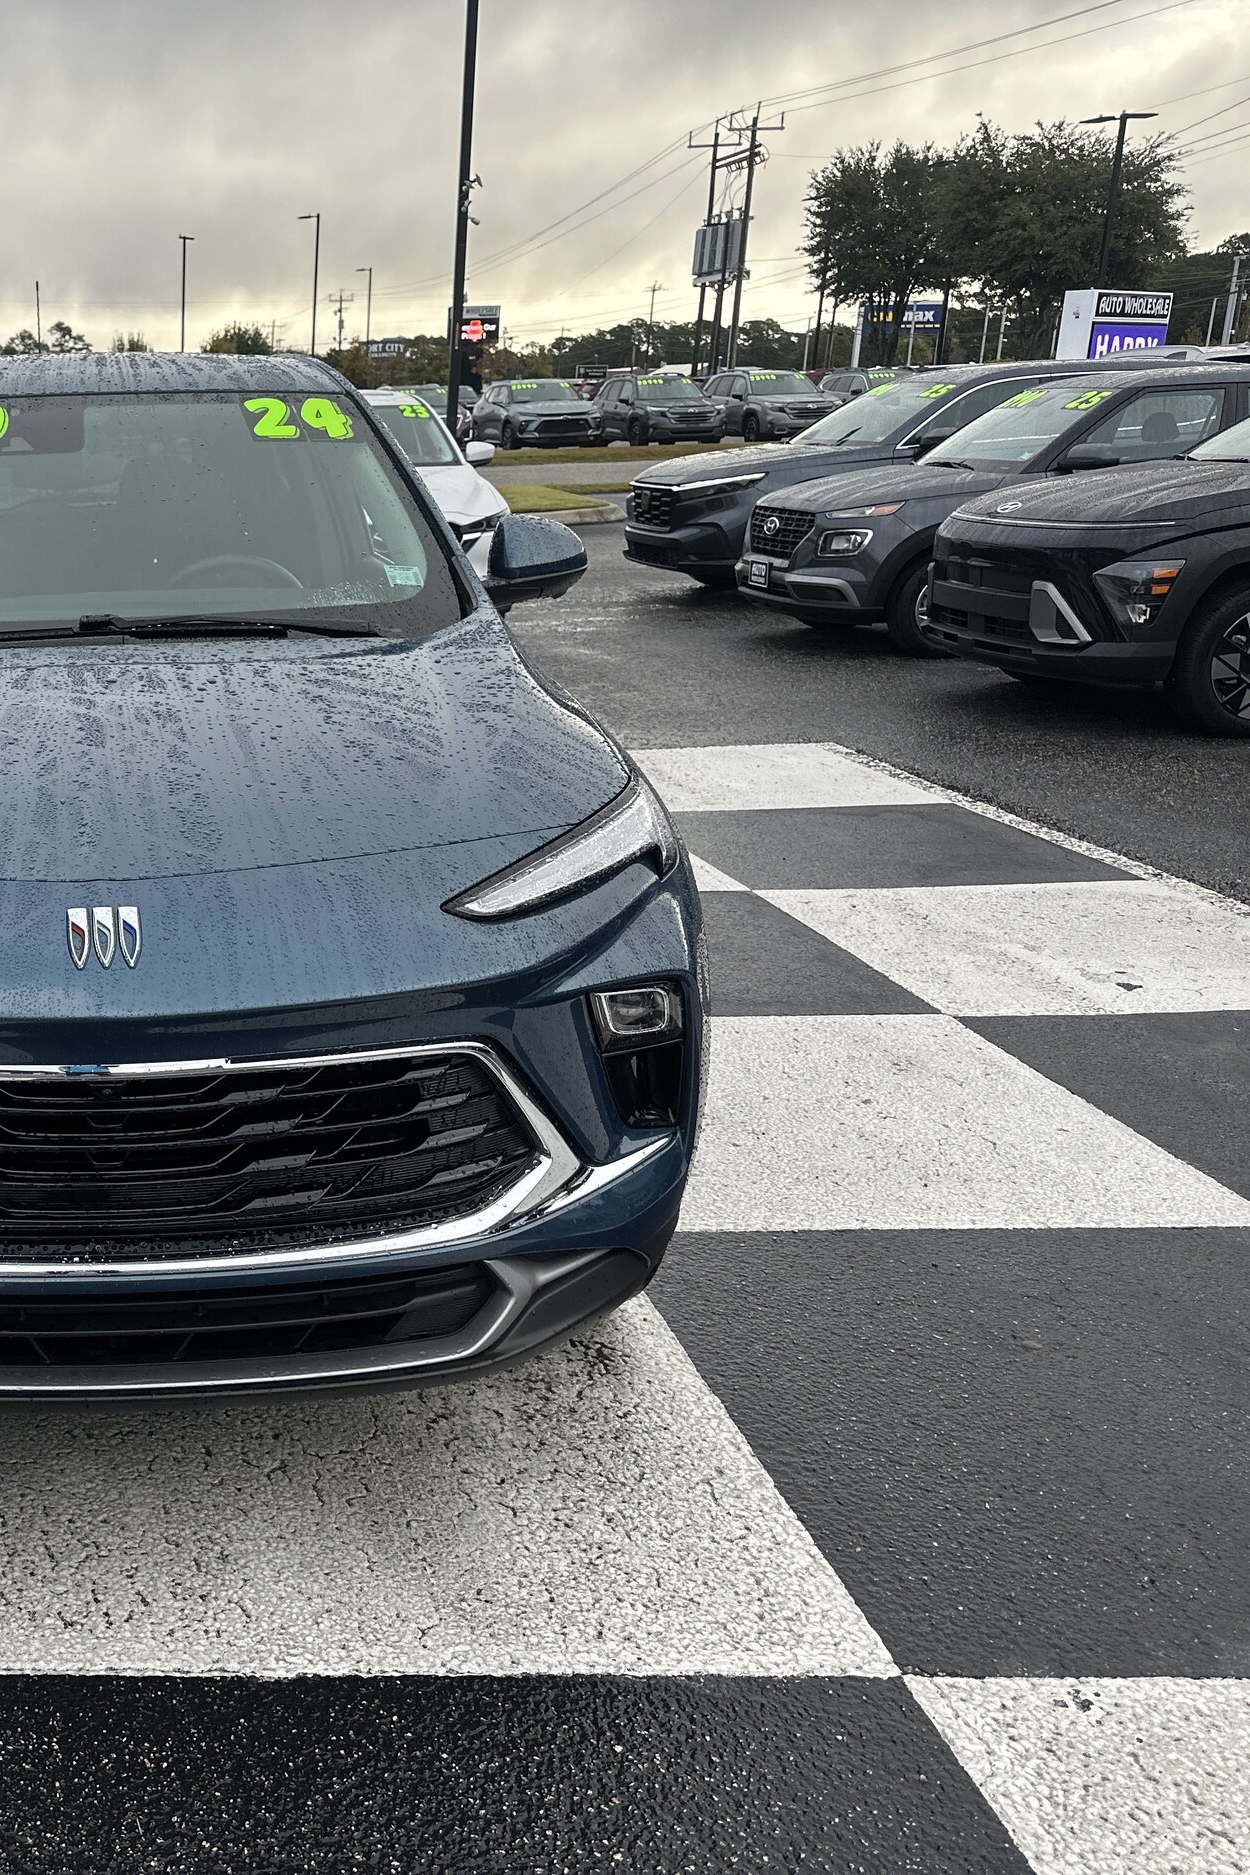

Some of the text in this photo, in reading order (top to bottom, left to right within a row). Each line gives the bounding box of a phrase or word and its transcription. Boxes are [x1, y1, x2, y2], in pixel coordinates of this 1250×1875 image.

[1098, 296, 1170, 315] AUTO WHOLESALE
[385, 343, 406, 353] CITY
[918, 383, 957, 398] 25
[1063, 390, 1113, 410] 25
[244, 397, 354, 439] 24
[398, 404, 430, 418] 23
